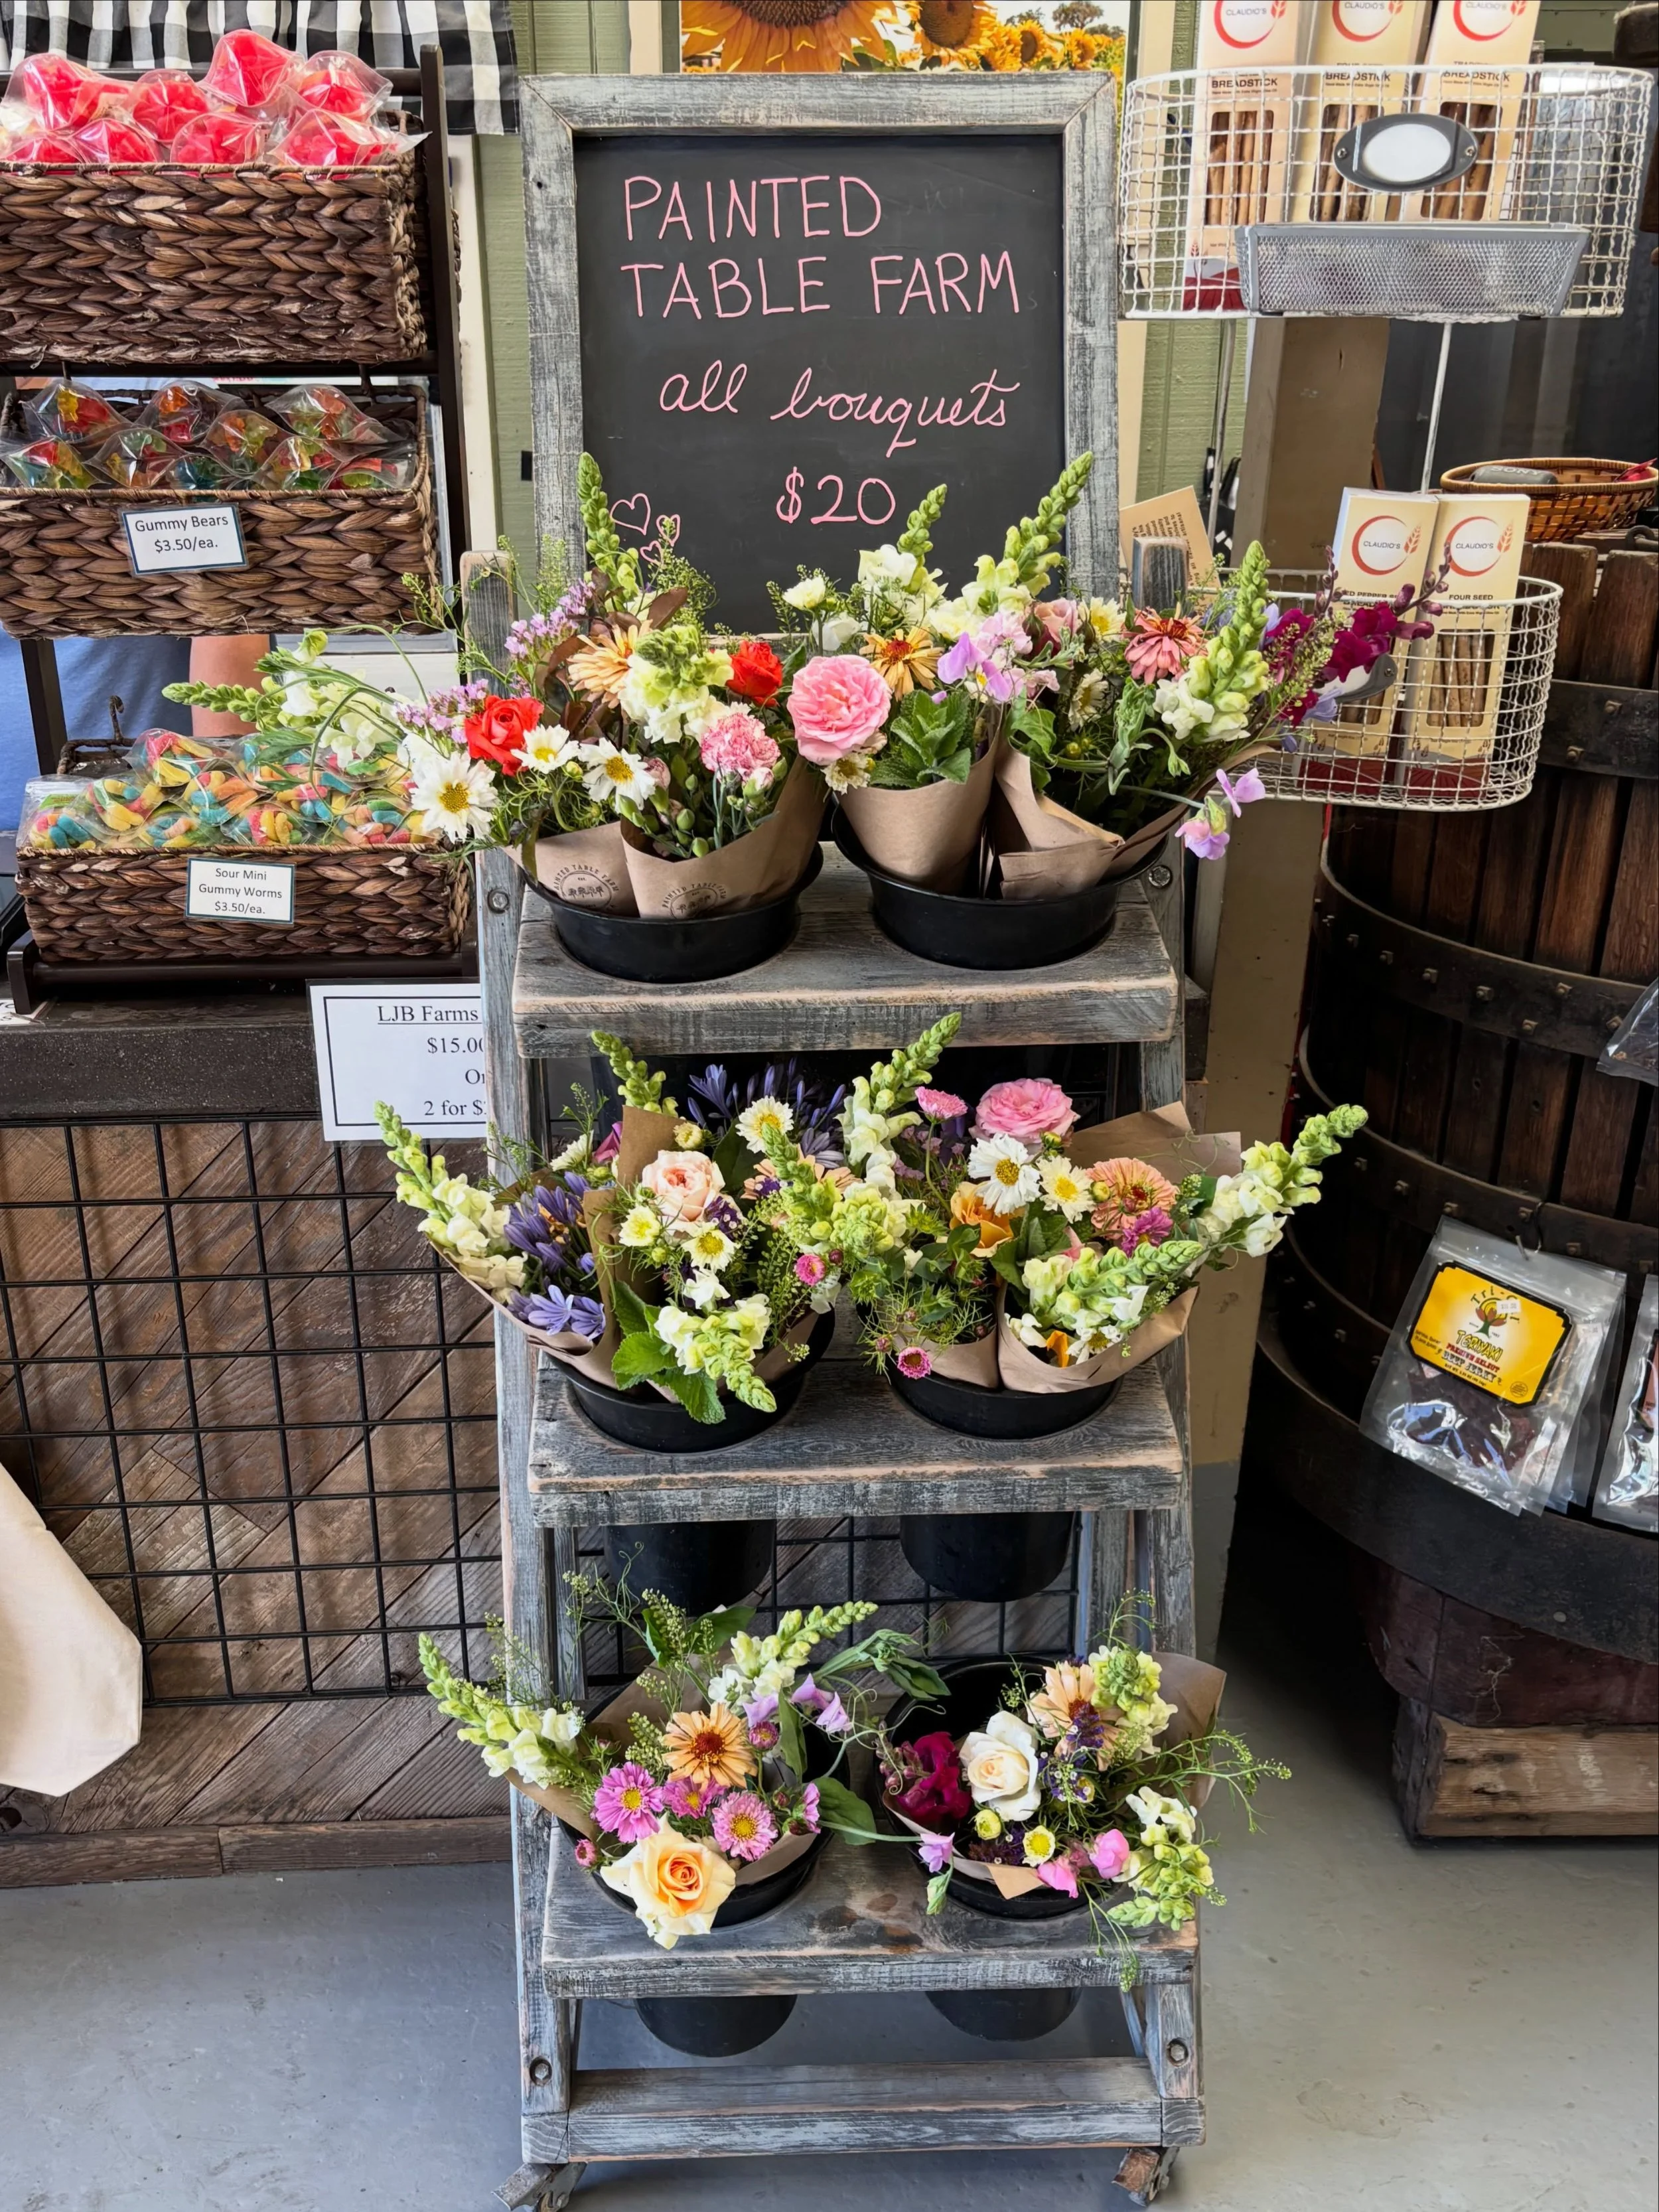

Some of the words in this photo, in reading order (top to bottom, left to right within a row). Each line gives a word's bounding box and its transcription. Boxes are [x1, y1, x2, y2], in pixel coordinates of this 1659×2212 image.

[624, 175, 882, 242] PAINTED
[620, 256, 831, 319] TABLE
[870, 251, 1020, 315] FARM
[659, 359, 748, 414] all
[770, 367, 1021, 459] bouquets
[1491, 467, 1542, 475] SONY
[776, 467, 896, 525] $20
[135, 520, 187, 532] Gummy
[191, 516, 228, 528] Bears
[154, 536, 218, 553] $3.50/ea.
[1363, 541, 1401, 550] CLAUDIO'S
[215, 867, 240, 878] Sour
[243, 870, 267, 881] Mini
[553, 867, 570, 891] AINTED
[571, 865, 599, 875] TABLE
[199, 883, 241, 897] Gummy
[244, 887, 282, 899] Worms
[215, 901, 265, 915] $3.50/ea.
[377, 1005, 415, 1022] LJB
[421, 1005, 478, 1021] Farms
[423, 1100, 435, 1116] 2
[441, 1100, 467, 1115] for
[1456, 1329, 1503, 1363] TERIYAKI
